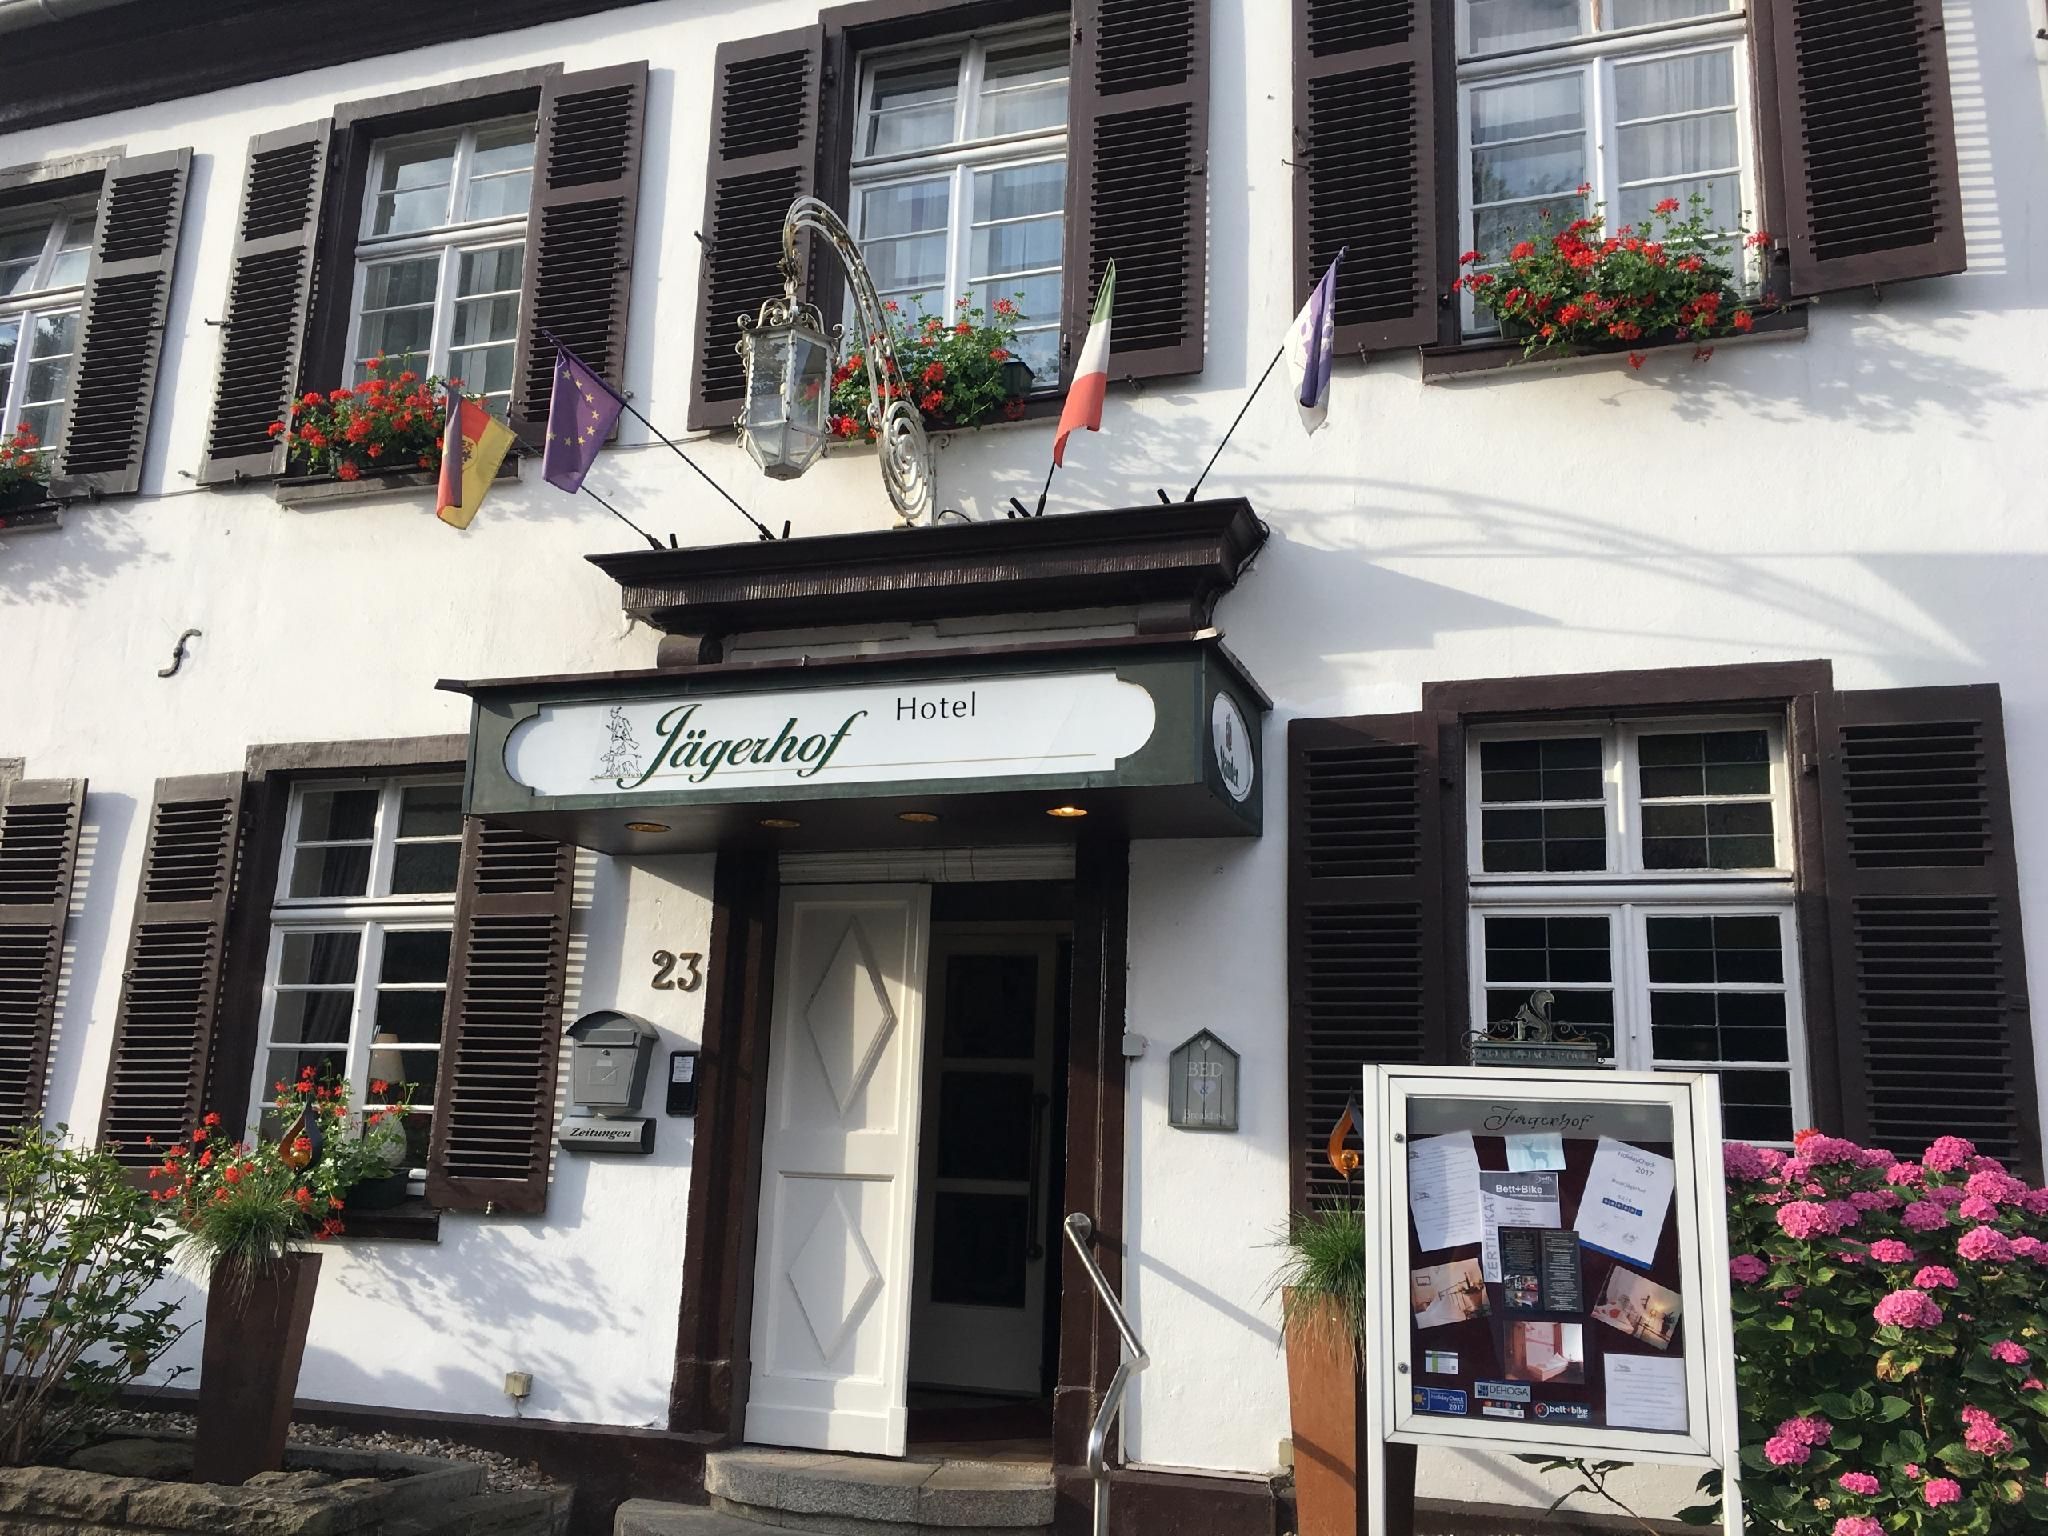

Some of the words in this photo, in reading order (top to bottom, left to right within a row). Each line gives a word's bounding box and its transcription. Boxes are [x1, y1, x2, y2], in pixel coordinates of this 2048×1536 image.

[895, 690, 976, 721] Hotel
[616, 703, 868, 790] Jägerhof
[651, 949, 703, 992] 23
[1186, 1061, 1223, 1078] BED
[1200, 1086, 1209, 1095] &
[569, 1127, 632, 1140] Zeitungen
[1634, 1167, 1655, 1177] 2017
[1495, 1184, 1543, 1194] Bett+Bike
[1483, 1193, 1499, 1280] ZERTIFIKAT
[1489, 1385, 1529, 1397] DEHOGA
